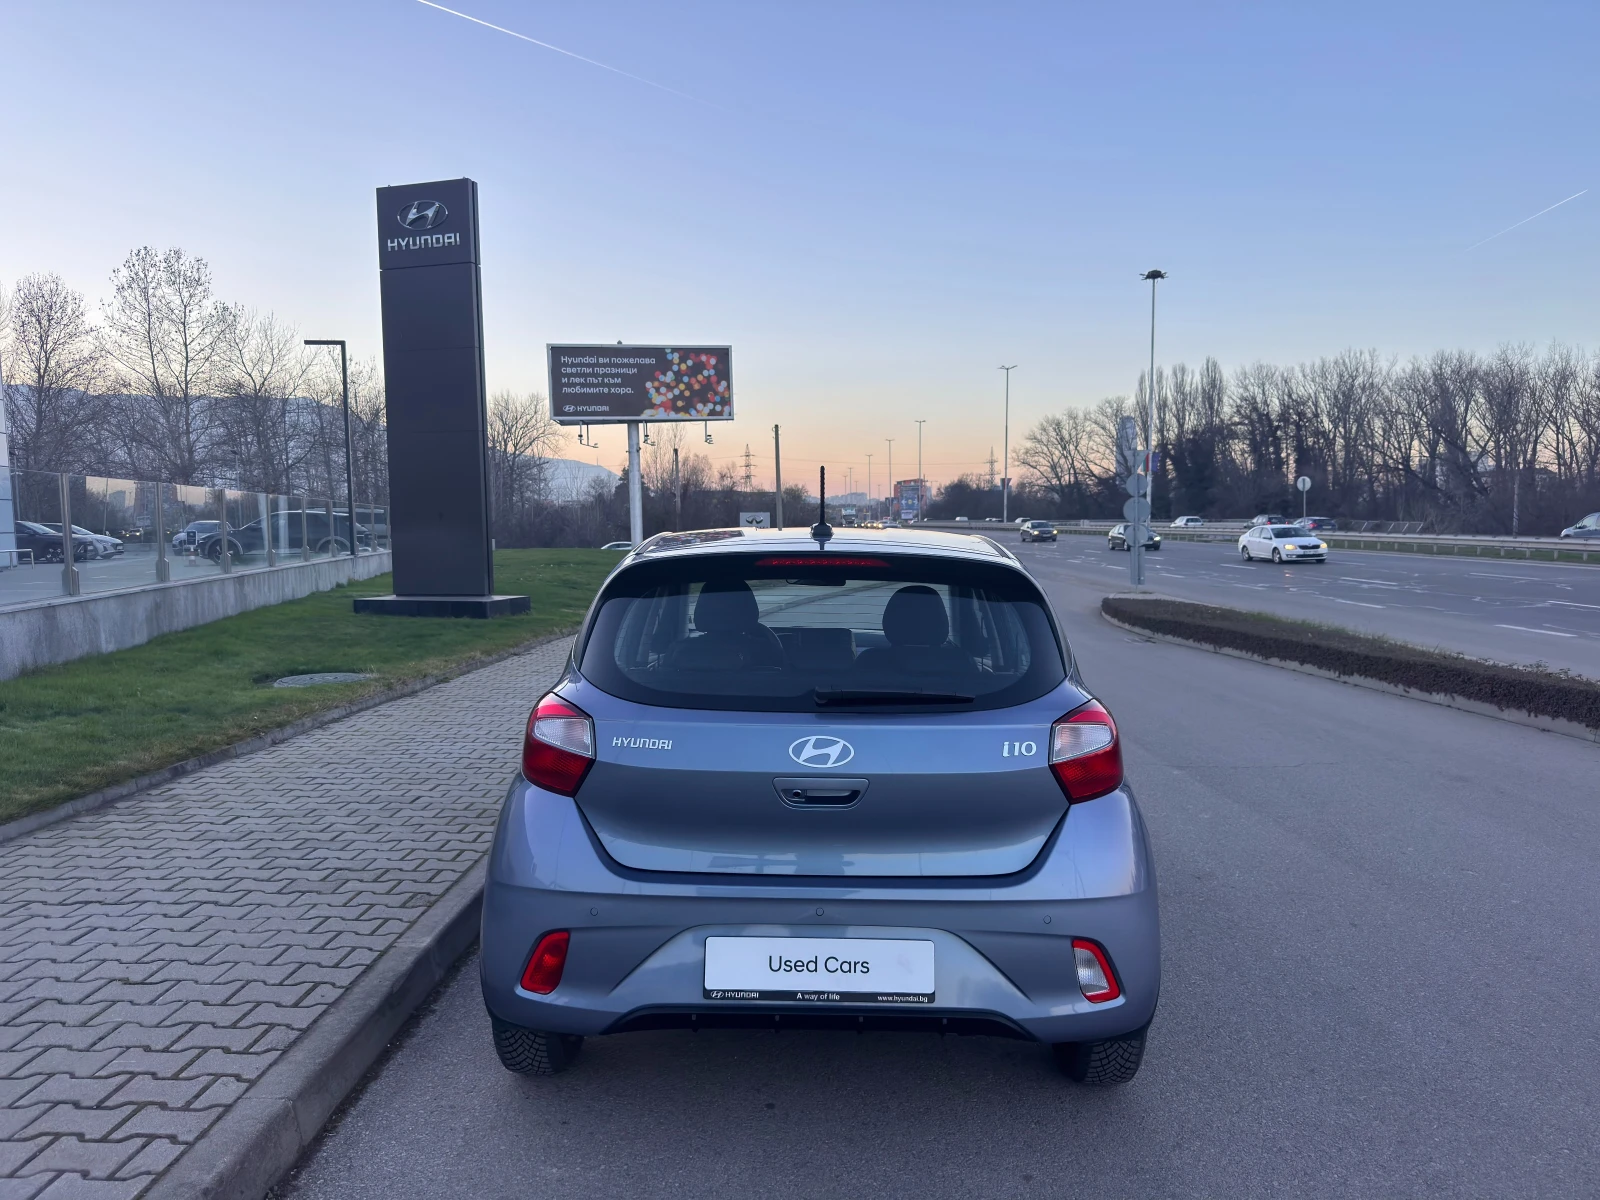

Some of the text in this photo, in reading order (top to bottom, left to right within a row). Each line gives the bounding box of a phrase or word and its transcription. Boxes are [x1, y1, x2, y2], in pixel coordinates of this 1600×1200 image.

[387, 232, 460, 251] HYUNDAI
[561, 355, 597, 364] Hyundai
[594, 367, 638, 375] празници
[610, 387, 634, 395] хора.
[612, 736, 672, 750] HYUNDAI
[1002, 741, 1037, 757] i10
[768, 955, 870, 974] Used Cars
[877, 994, 928, 1002] www.hyundai.bg
